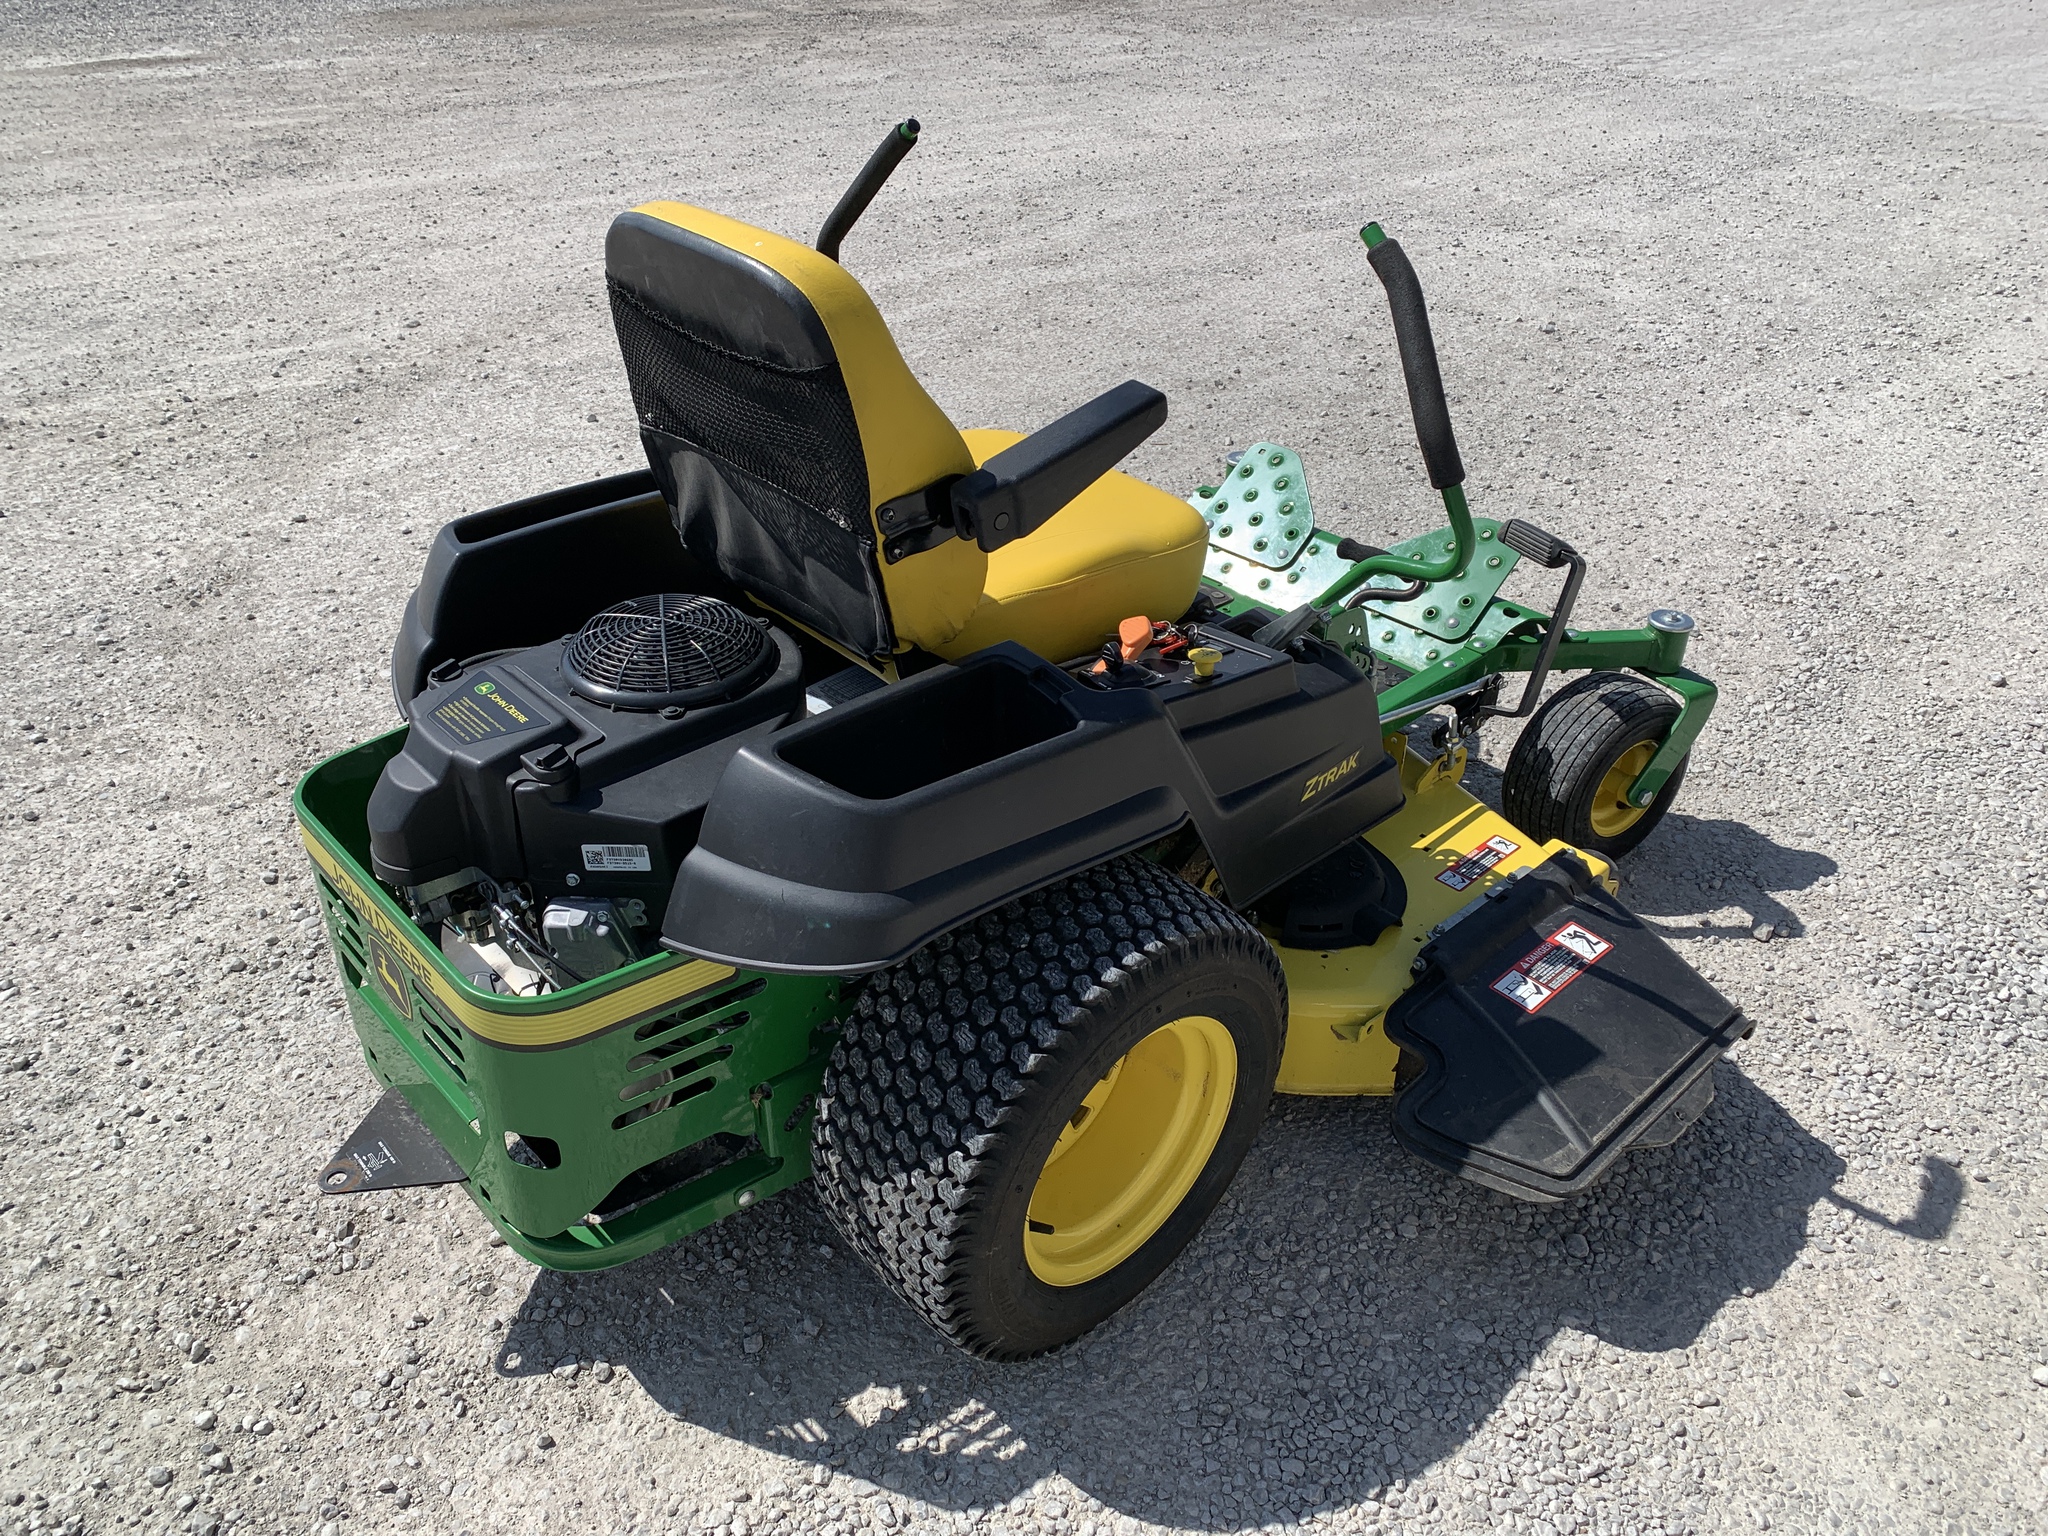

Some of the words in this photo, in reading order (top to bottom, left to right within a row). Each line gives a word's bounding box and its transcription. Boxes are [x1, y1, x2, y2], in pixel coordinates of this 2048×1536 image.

[487, 693, 509, 709] JOHN
[505, 704, 529, 724] DEERE
[1301, 751, 1360, 802] ZTRAK
[331, 864, 374, 925] JOHN
[374, 910, 435, 991] DEERE
[1525, 942, 1555, 964] DANGER
